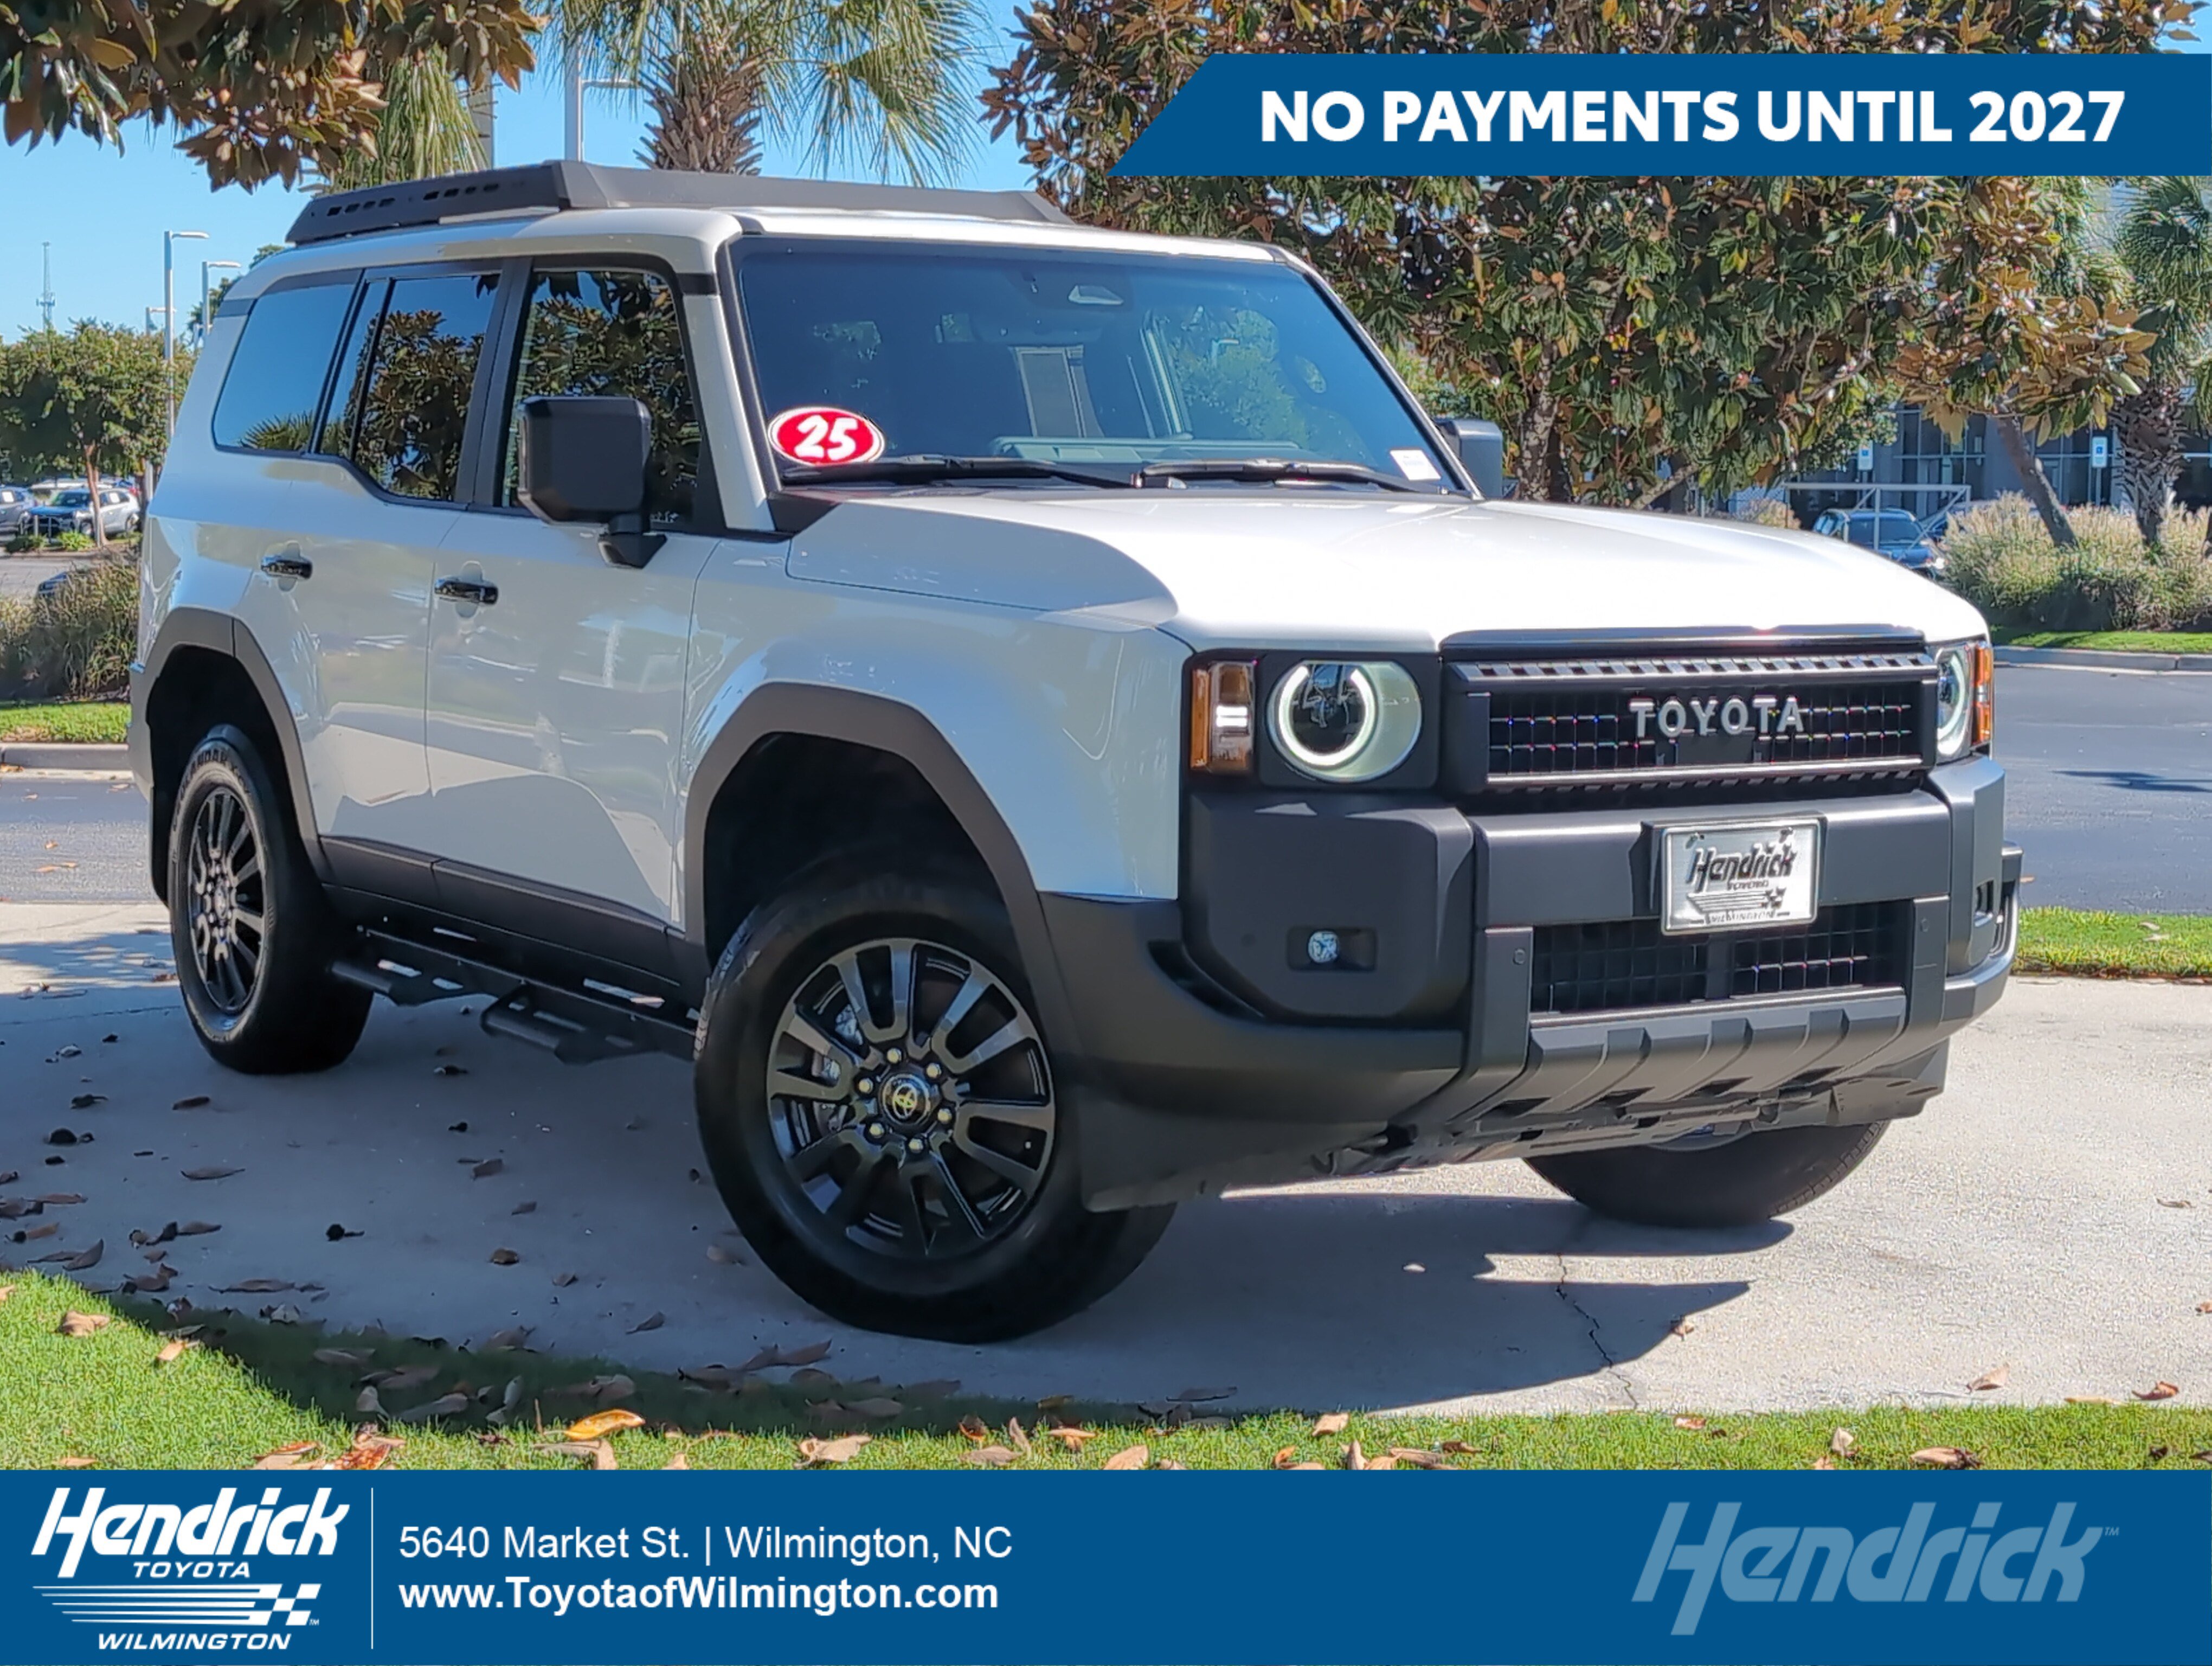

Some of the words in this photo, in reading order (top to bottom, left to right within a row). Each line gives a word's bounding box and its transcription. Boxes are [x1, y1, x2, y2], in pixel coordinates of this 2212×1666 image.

[794, 415, 858, 461] 25
[1629, 694, 1804, 738] TOYOTA
[1686, 842, 1797, 893] Hendrick
